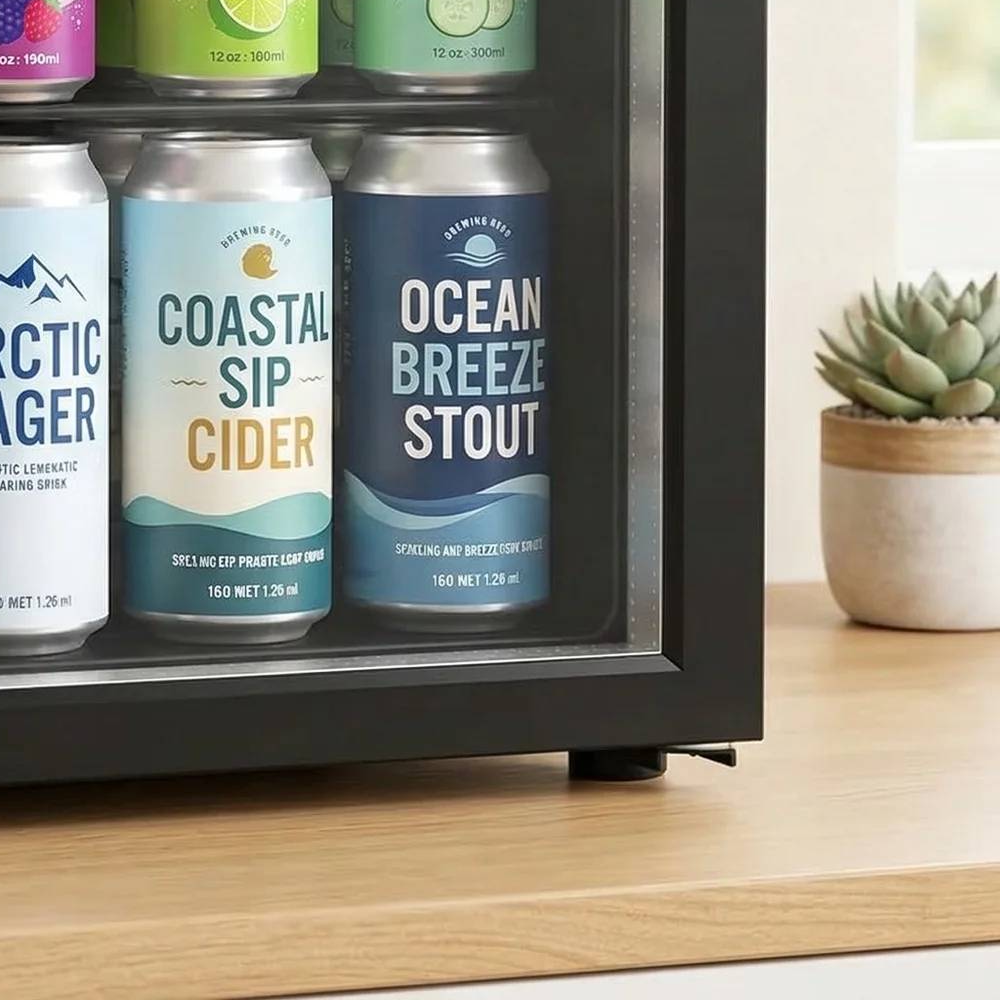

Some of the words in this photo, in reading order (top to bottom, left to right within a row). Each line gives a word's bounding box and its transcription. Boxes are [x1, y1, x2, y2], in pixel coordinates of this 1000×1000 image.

[157, 290, 329, 348] COASTAL
[400, 276, 542, 334] OCEAN
[218, 356, 292, 409] SIP
[391, 338, 546, 397] BREEZE
[187, 415, 315, 471] CIDER
[403, 401, 539, 460] STOUT
